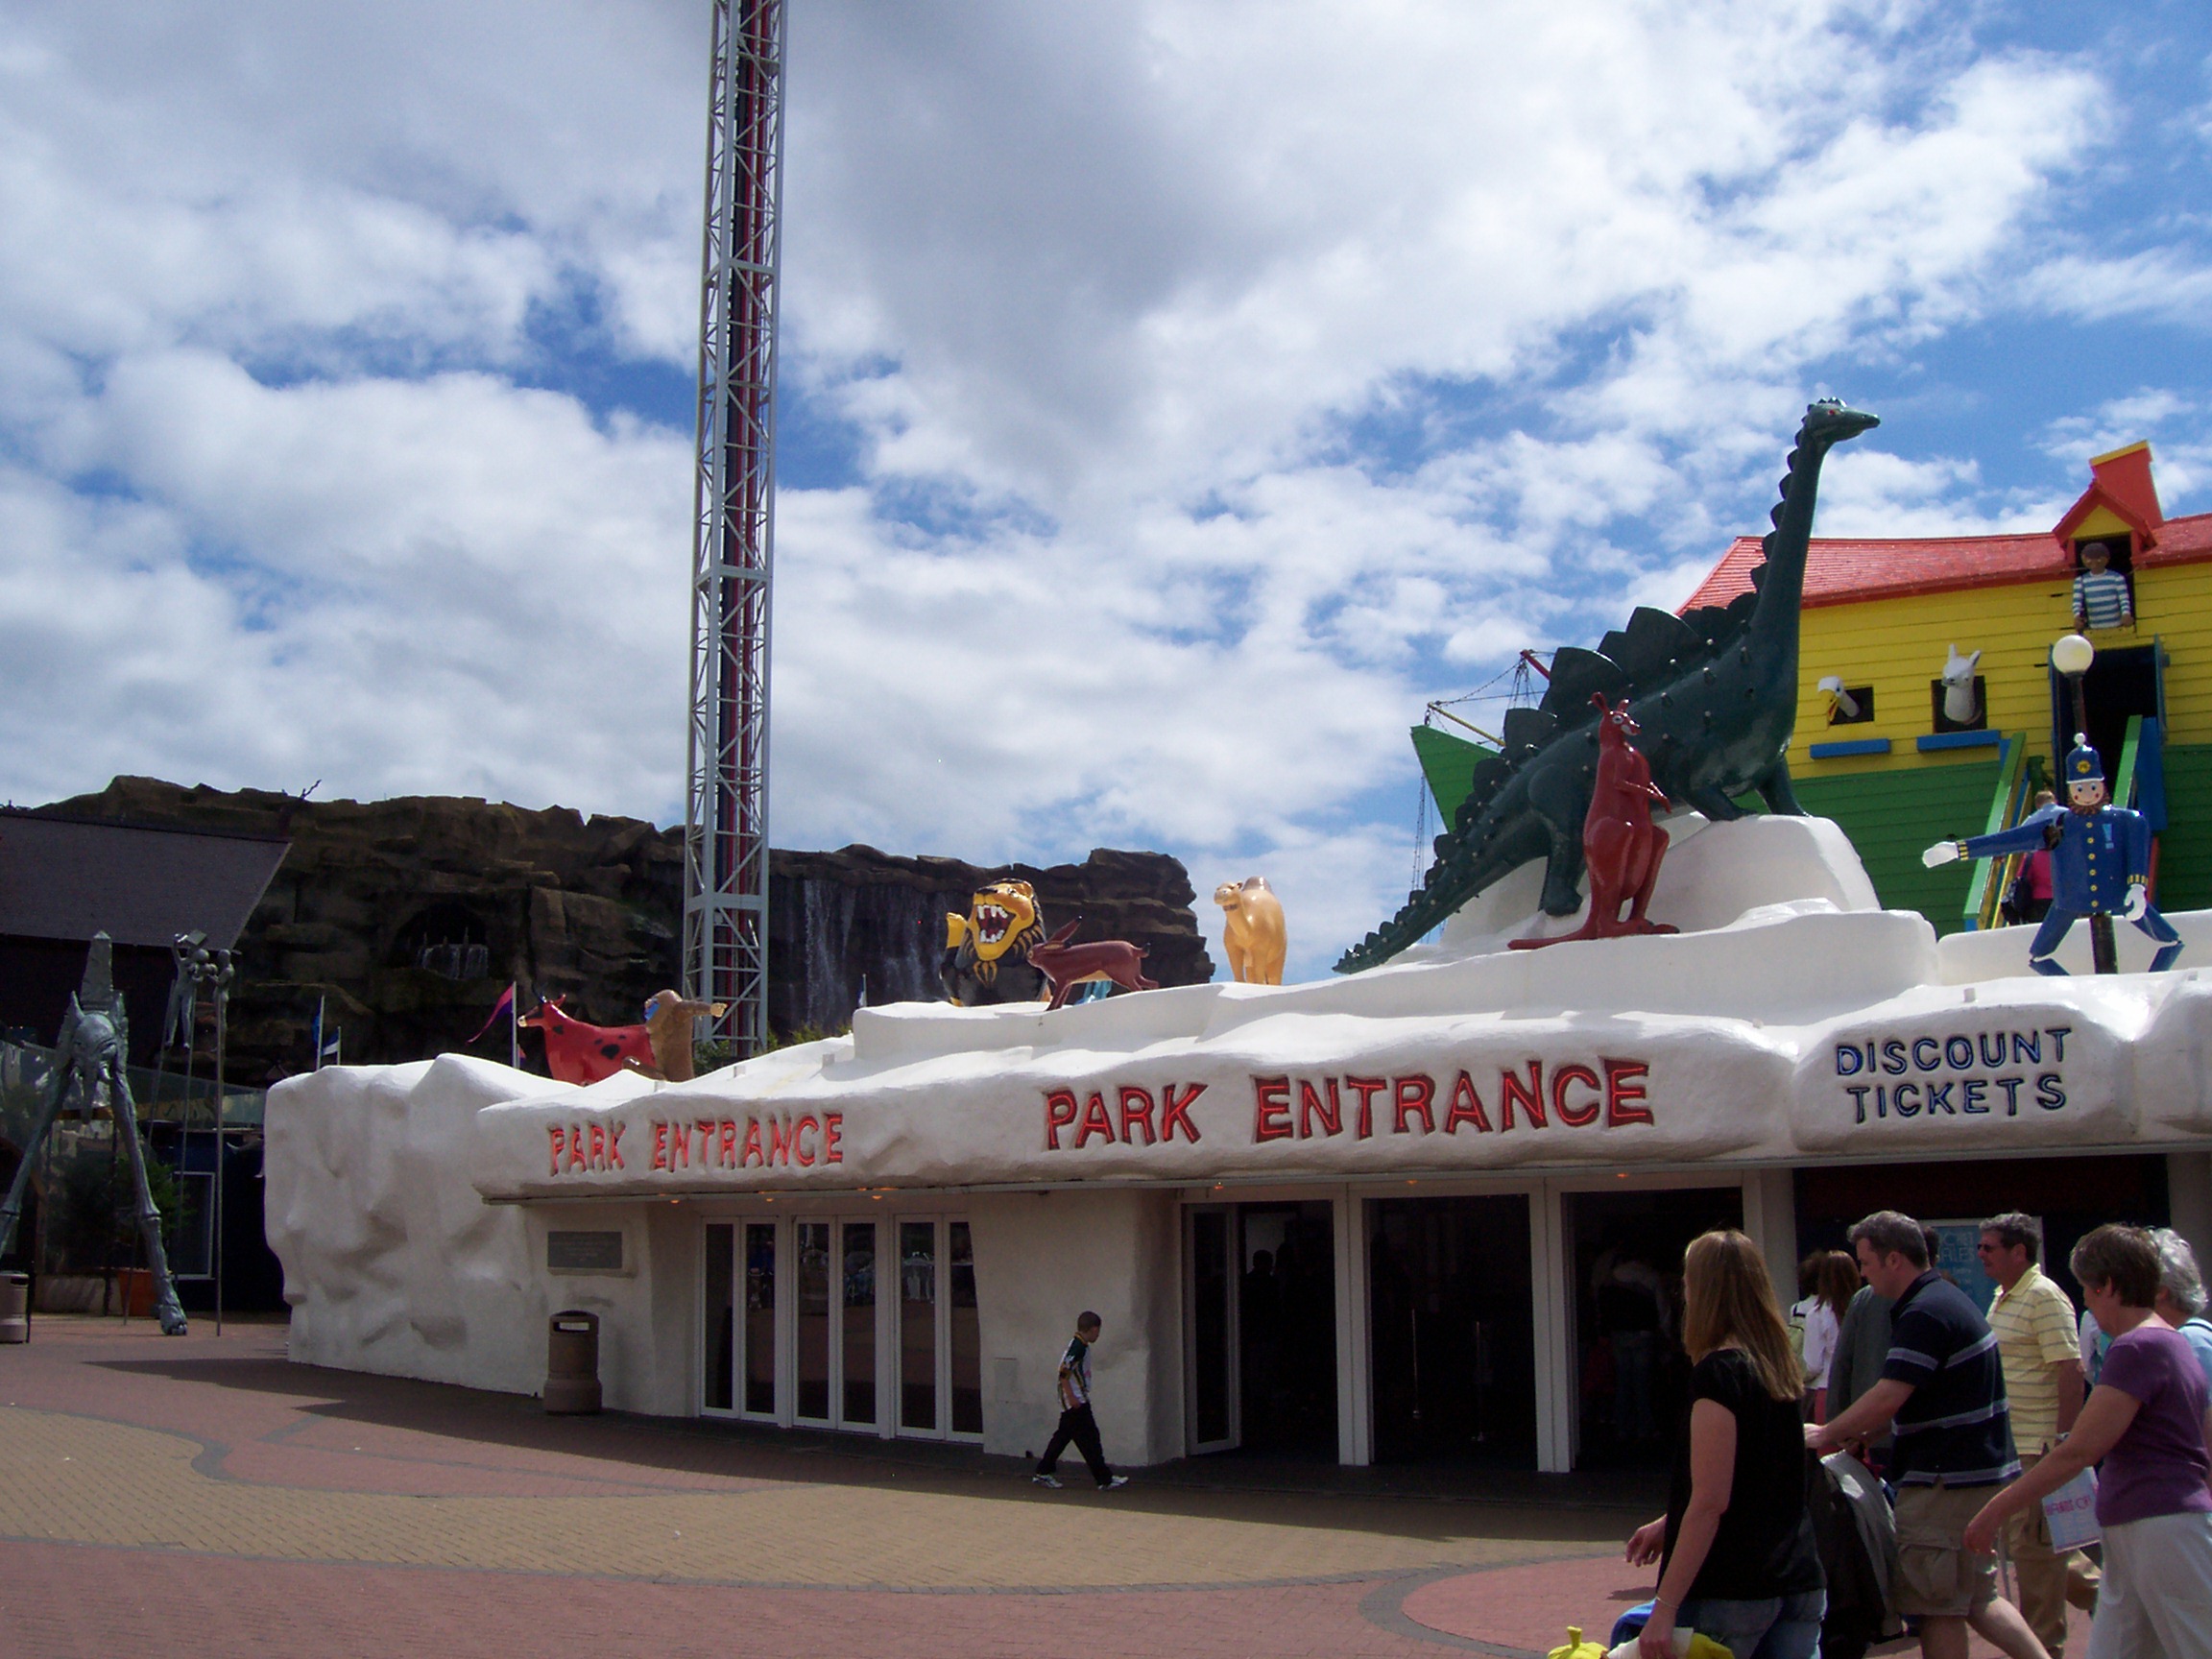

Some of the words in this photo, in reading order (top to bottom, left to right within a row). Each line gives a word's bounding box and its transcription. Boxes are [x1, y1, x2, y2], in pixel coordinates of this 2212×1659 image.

[1836, 1027, 2072, 1075] DISCOUNT
[1043, 1082, 1209, 1151] PARK
[1250, 1057, 1654, 1144] ENTRANCE
[1847, 1074, 2067, 1124] TICKETS
[548, 1120, 626, 1177] PARK
[650, 1112, 844, 1173] ENTRANCE
